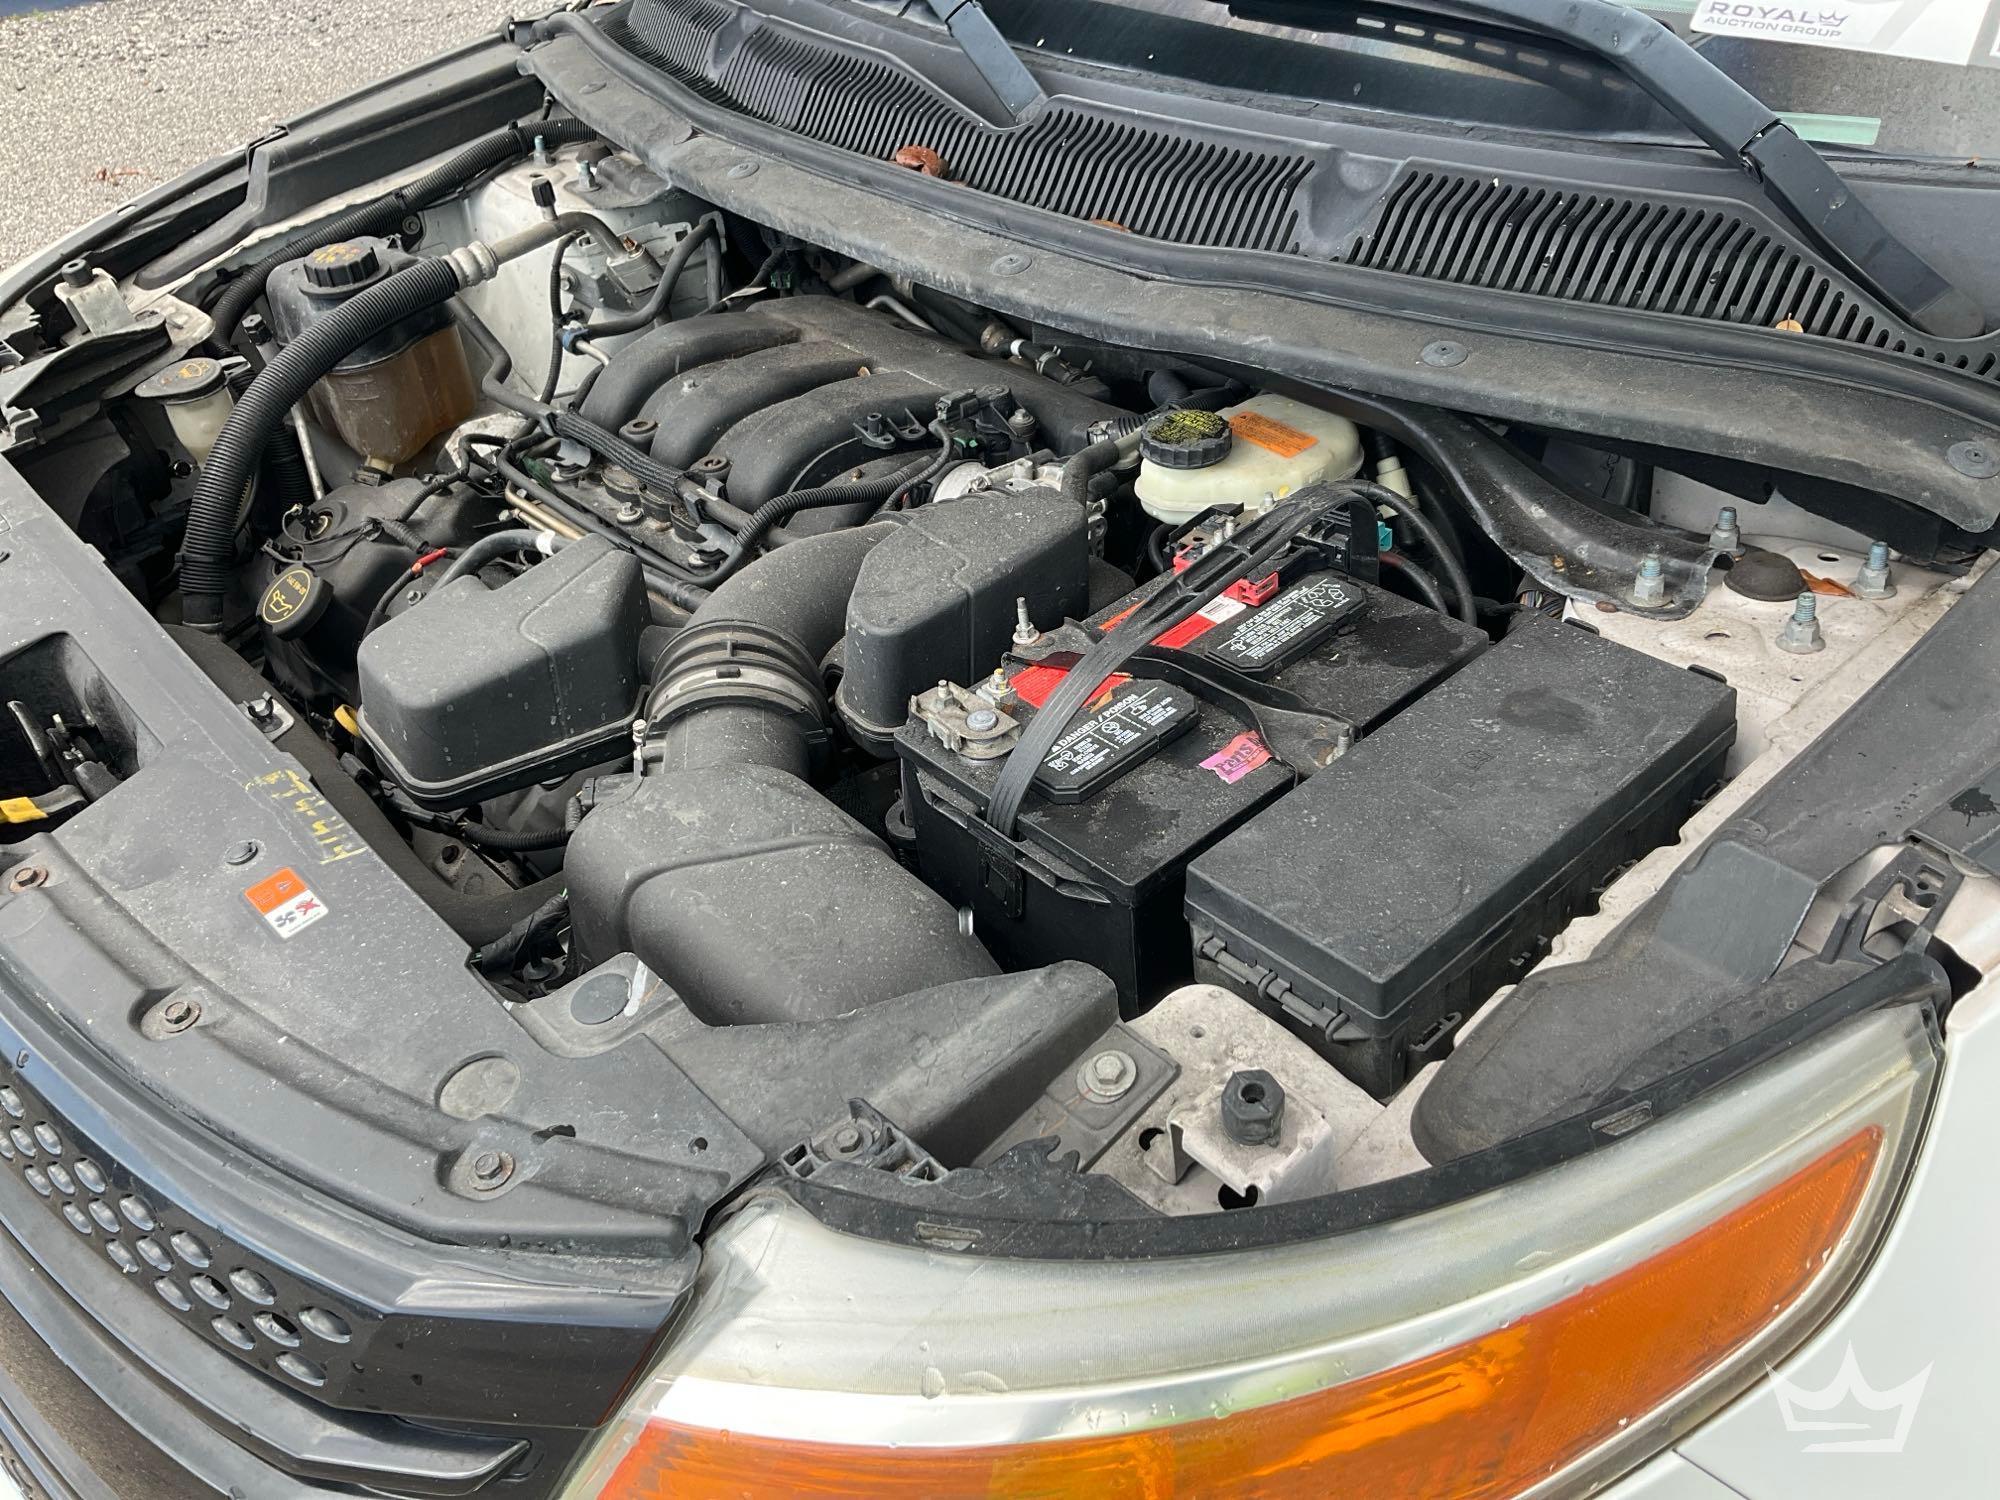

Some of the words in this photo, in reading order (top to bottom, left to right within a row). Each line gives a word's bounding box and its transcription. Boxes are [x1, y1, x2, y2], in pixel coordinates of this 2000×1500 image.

[1709, 1, 1815, 24] ROYAL
[1704, 16, 1779, 31] AUCTION
[1781, 24, 1842, 38] GROUP
[1058, 719, 1099, 747] DANGER
[1102, 693, 1139, 718] POISON
